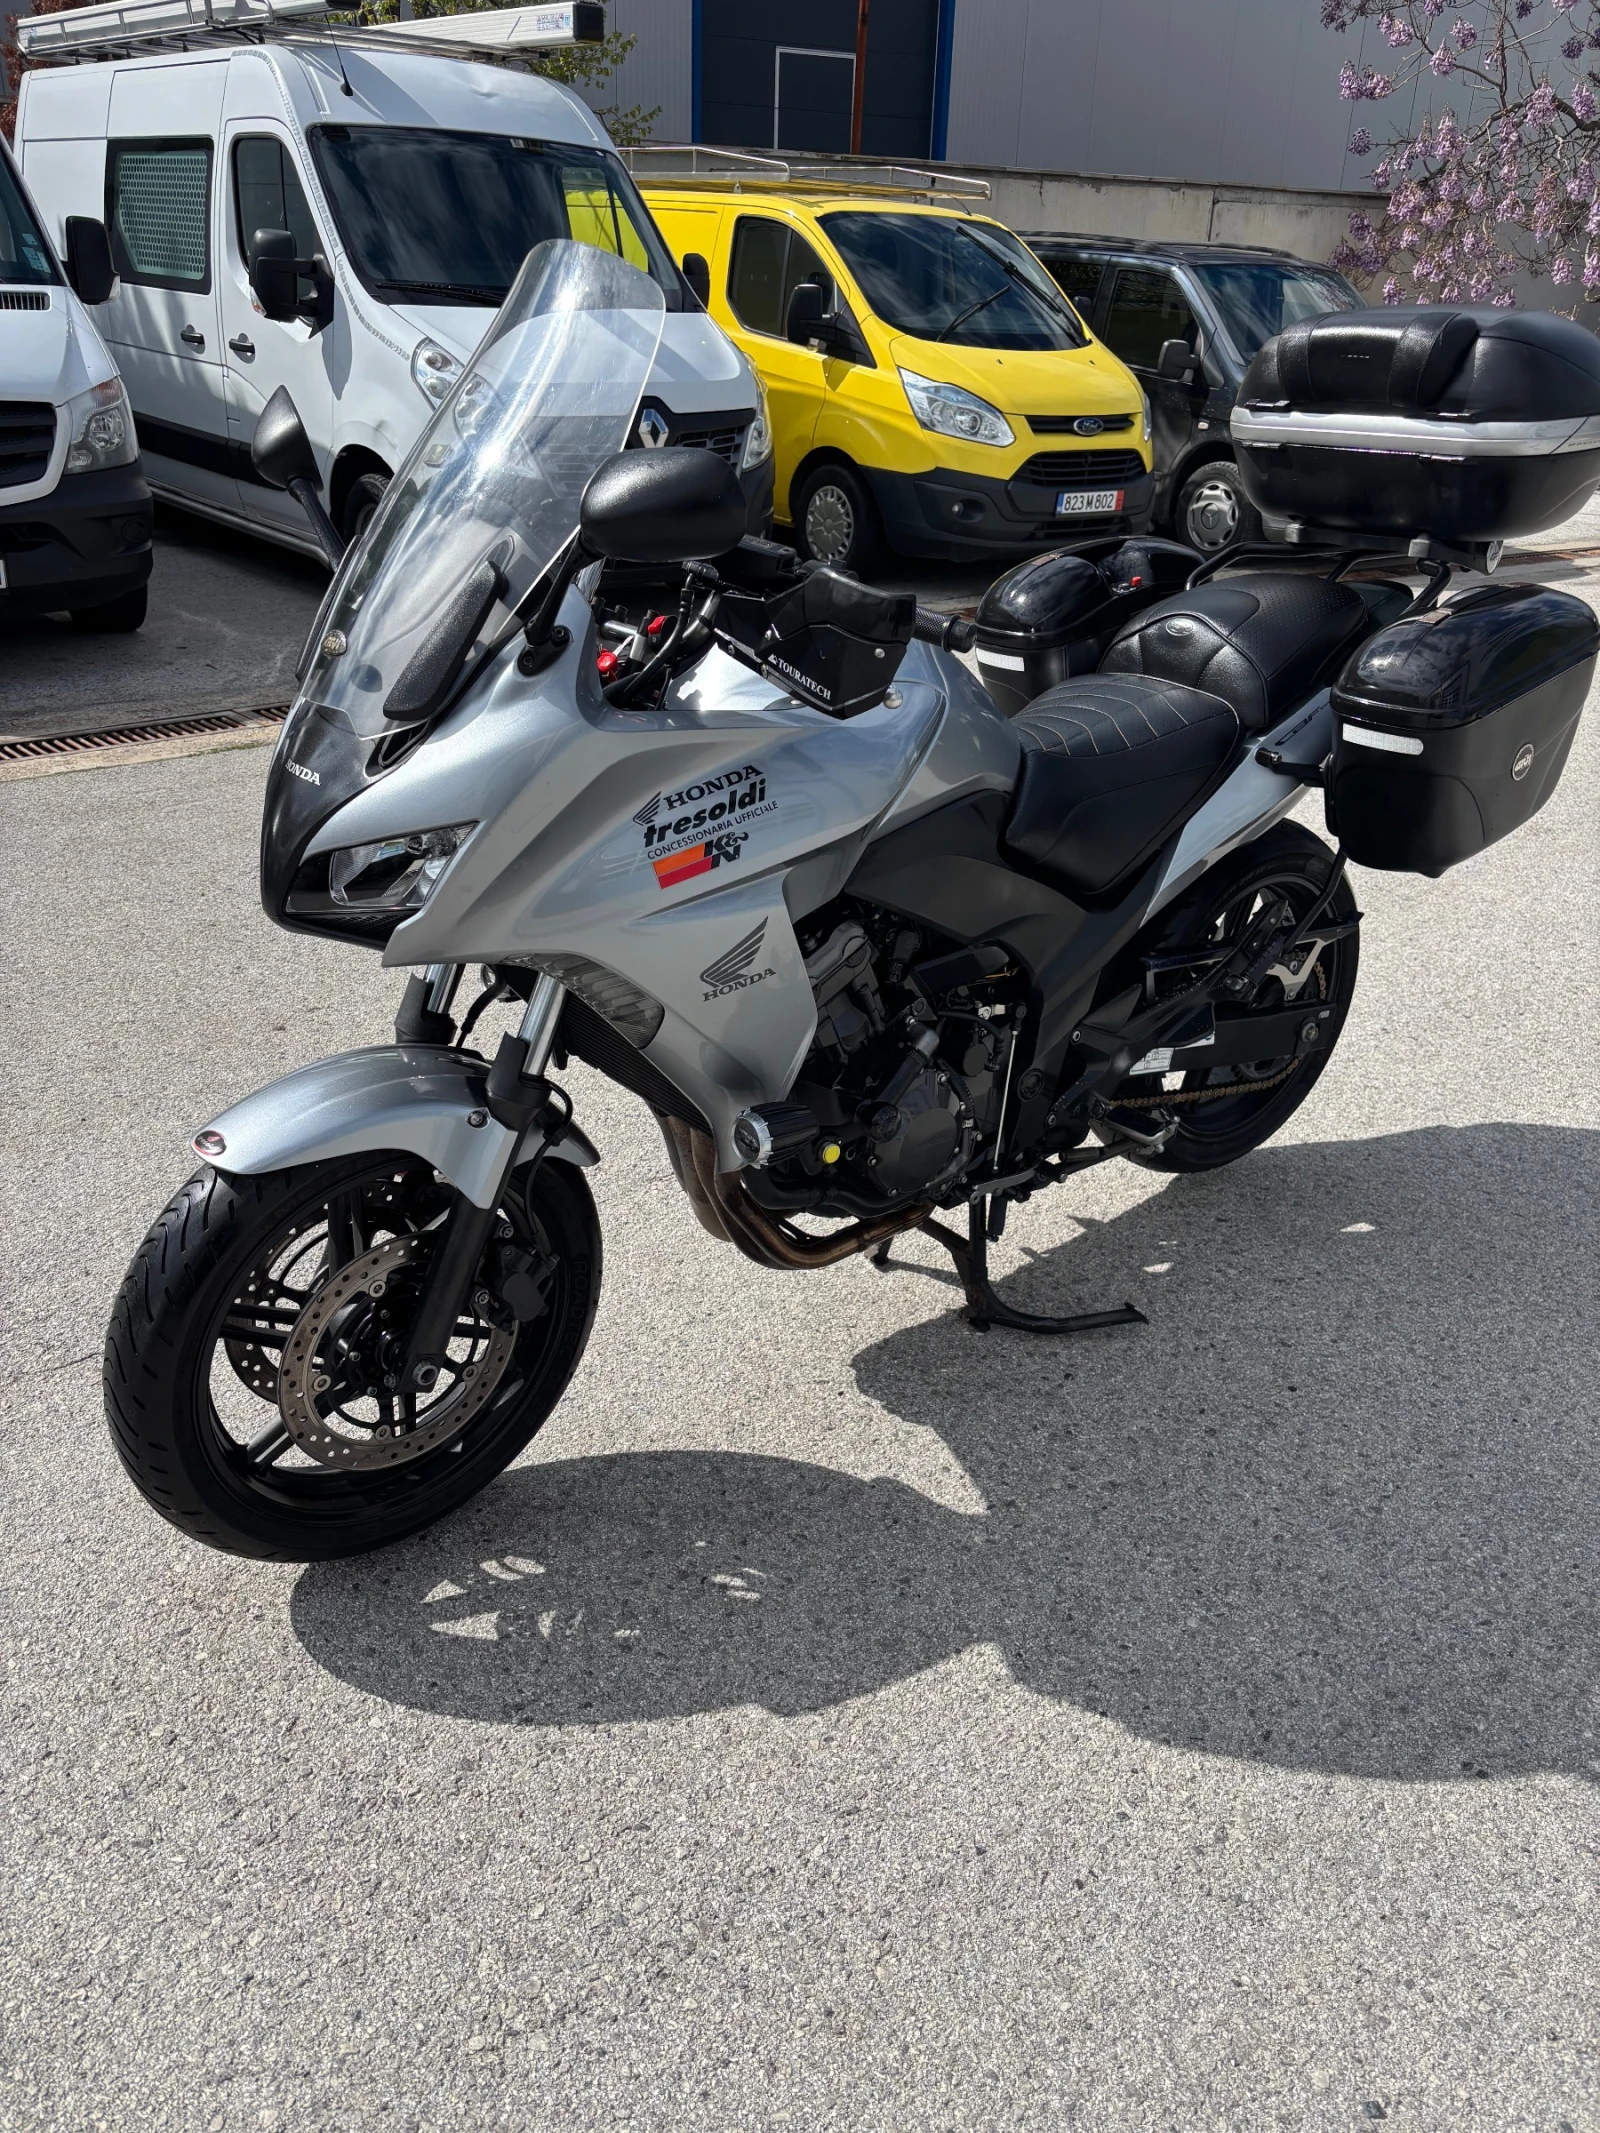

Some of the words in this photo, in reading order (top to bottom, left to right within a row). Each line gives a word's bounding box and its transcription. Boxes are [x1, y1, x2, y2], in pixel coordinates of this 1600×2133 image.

[1064, 495, 1084, 511] 823
[1094, 493, 1114, 509] 802
[778, 657, 831, 700] TOURATECH
[285, 758, 321, 786] HONDA
[663, 765, 764, 811] HONDA
[643, 778, 766, 848] tresoldi
[647, 822, 733, 860] CONCESSIONARIA
[734, 800, 779, 825] UFFICIALE
[702, 967, 777, 1002] HONDA
